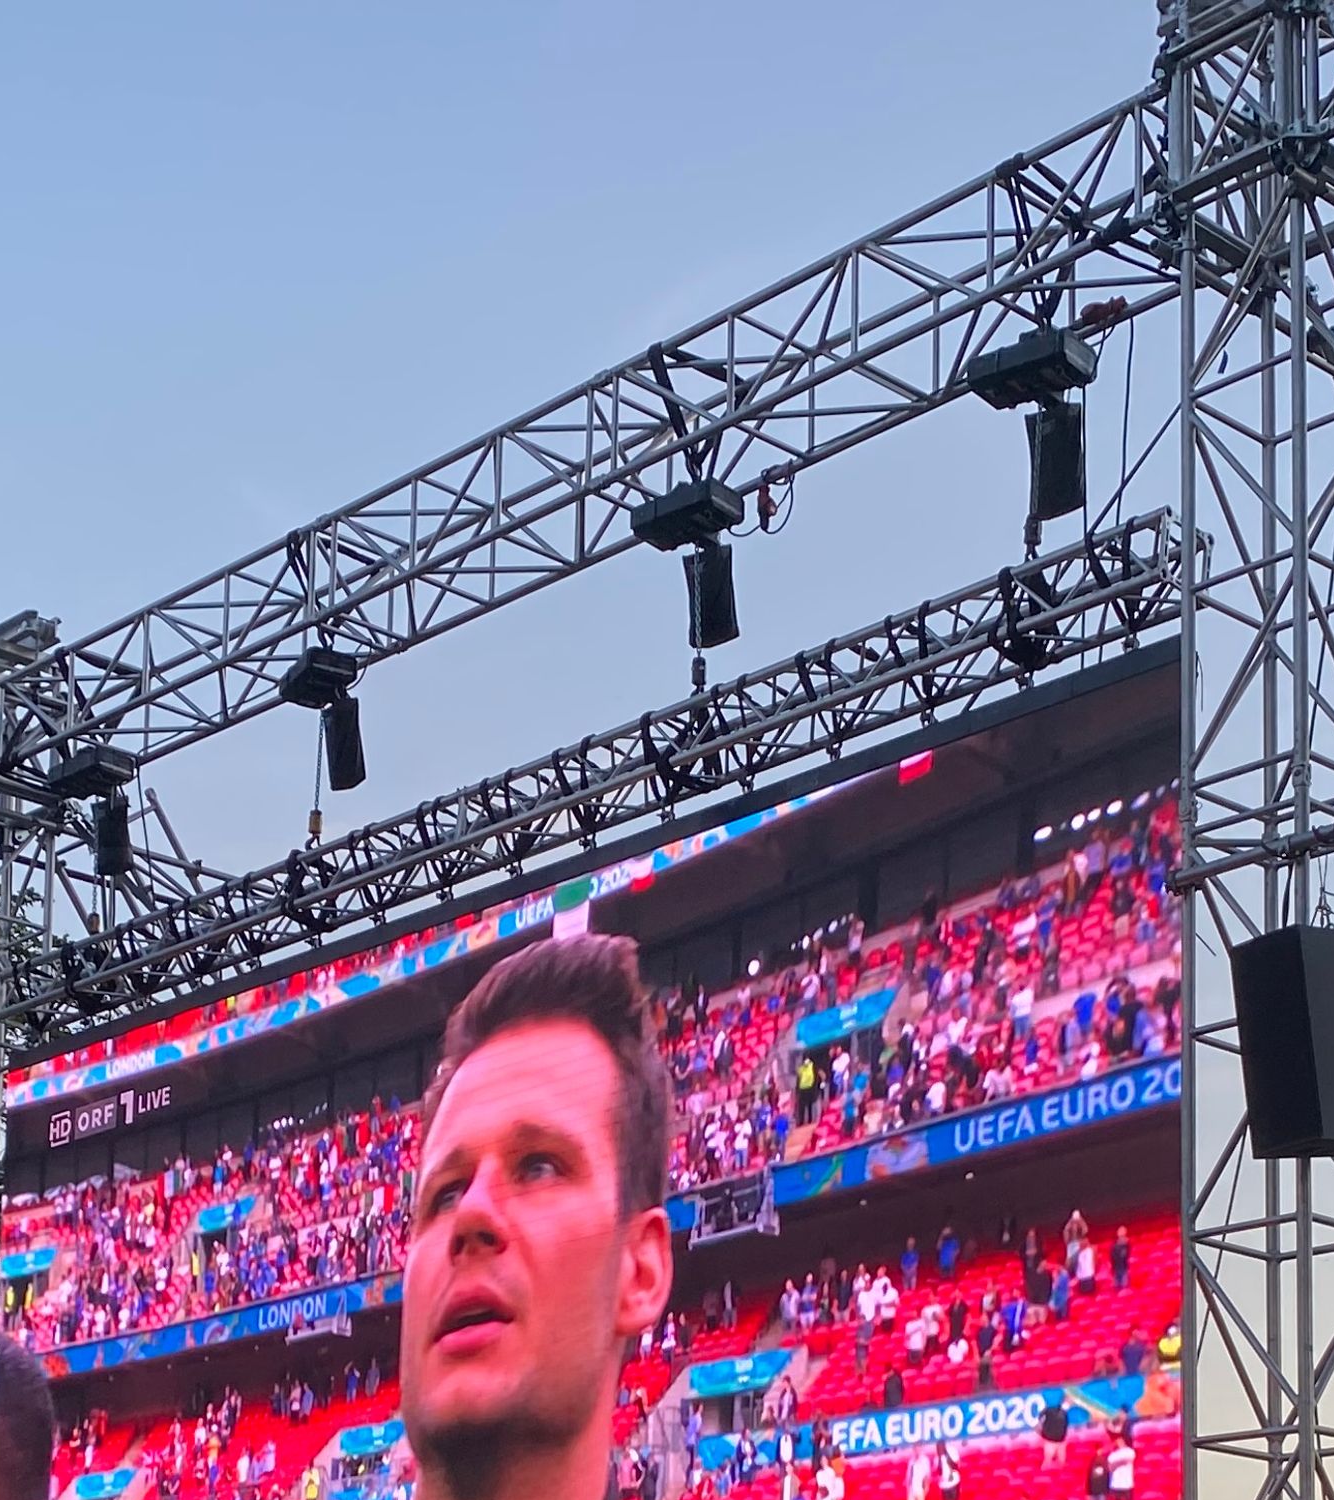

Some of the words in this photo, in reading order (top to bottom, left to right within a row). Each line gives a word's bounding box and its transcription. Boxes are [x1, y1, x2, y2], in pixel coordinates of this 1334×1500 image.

[49, 1117, 73, 1141] HD
[77, 1103, 115, 1132] ORF
[120, 1090, 135, 1125] 1
[137, 1086, 171, 1114] LIVE
[954, 1104, 1036, 1153] UEFA
[1041, 1075, 1136, 1131] EURO
[258, 1293, 327, 1331] LONDON
[831, 1419, 883, 1451] EFA
[884, 1405, 964, 1446] EURO
[967, 1393, 1046, 1435] 2020
